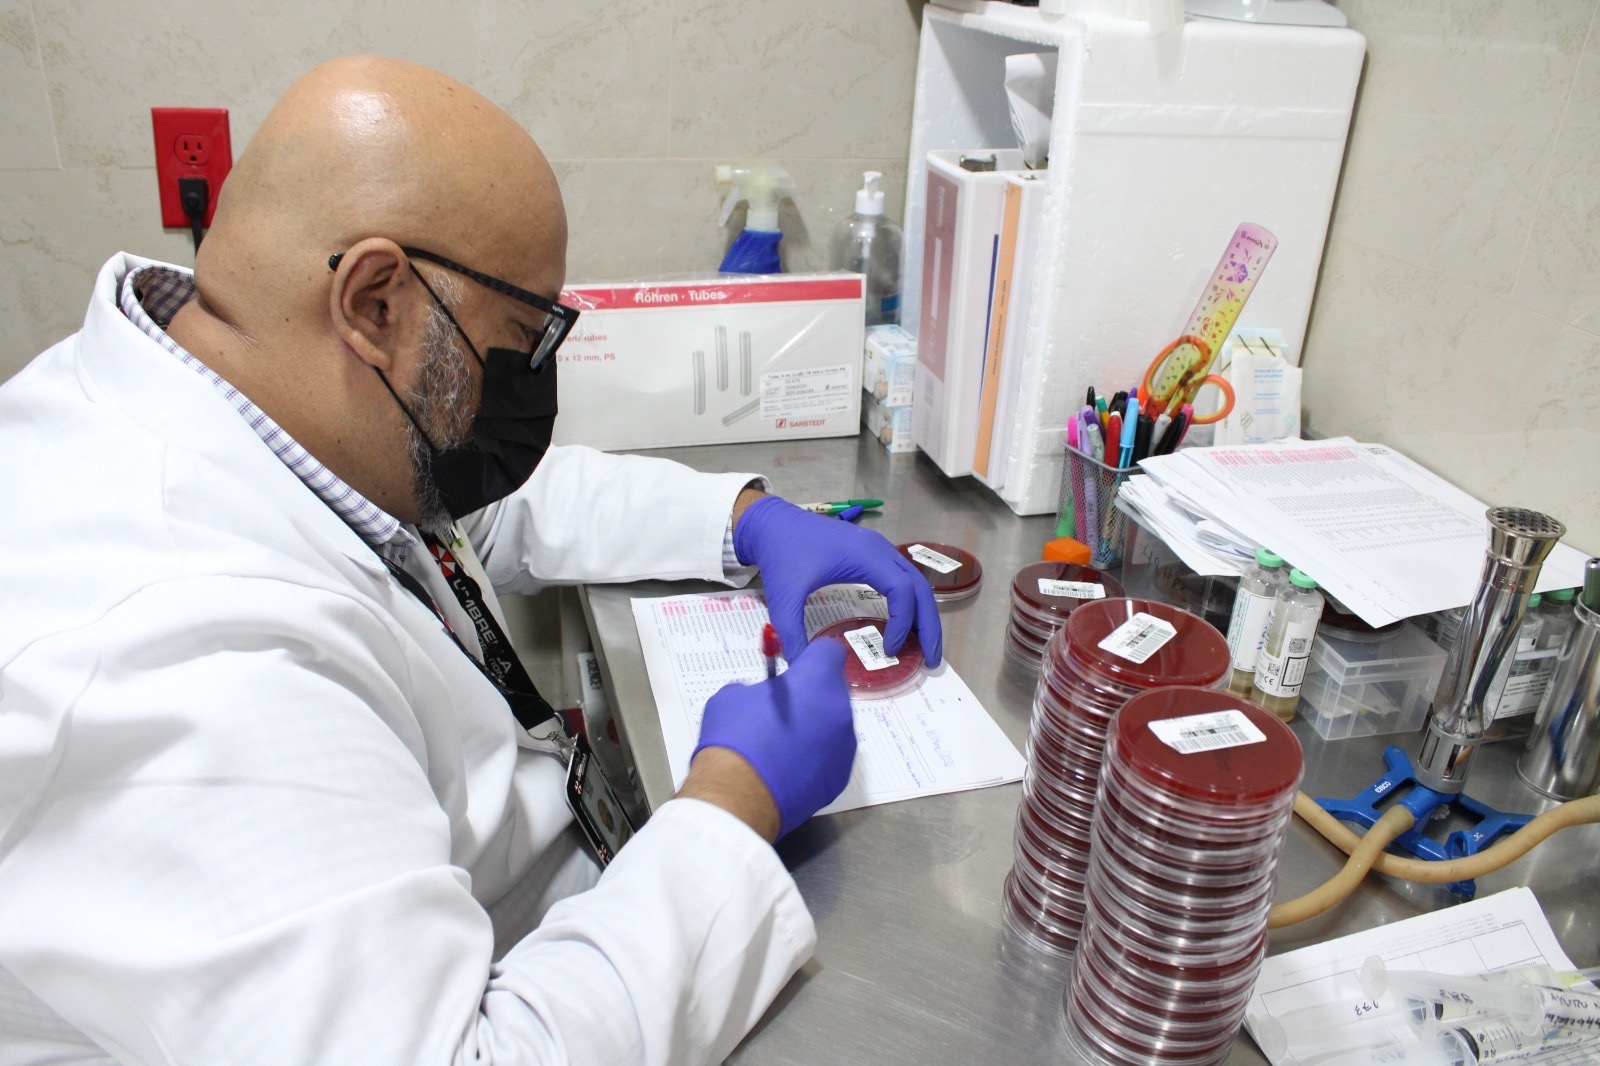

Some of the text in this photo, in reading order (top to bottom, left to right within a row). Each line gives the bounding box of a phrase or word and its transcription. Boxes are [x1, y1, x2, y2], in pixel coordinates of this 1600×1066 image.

[635, 288, 725, 304] Röhren Tubes
[573, 354, 581, 362] 12
[604, 353, 616, 361] PS
[789, 419, 826, 428] SARSTEDT
[453, 579, 512, 674] UMBREA
